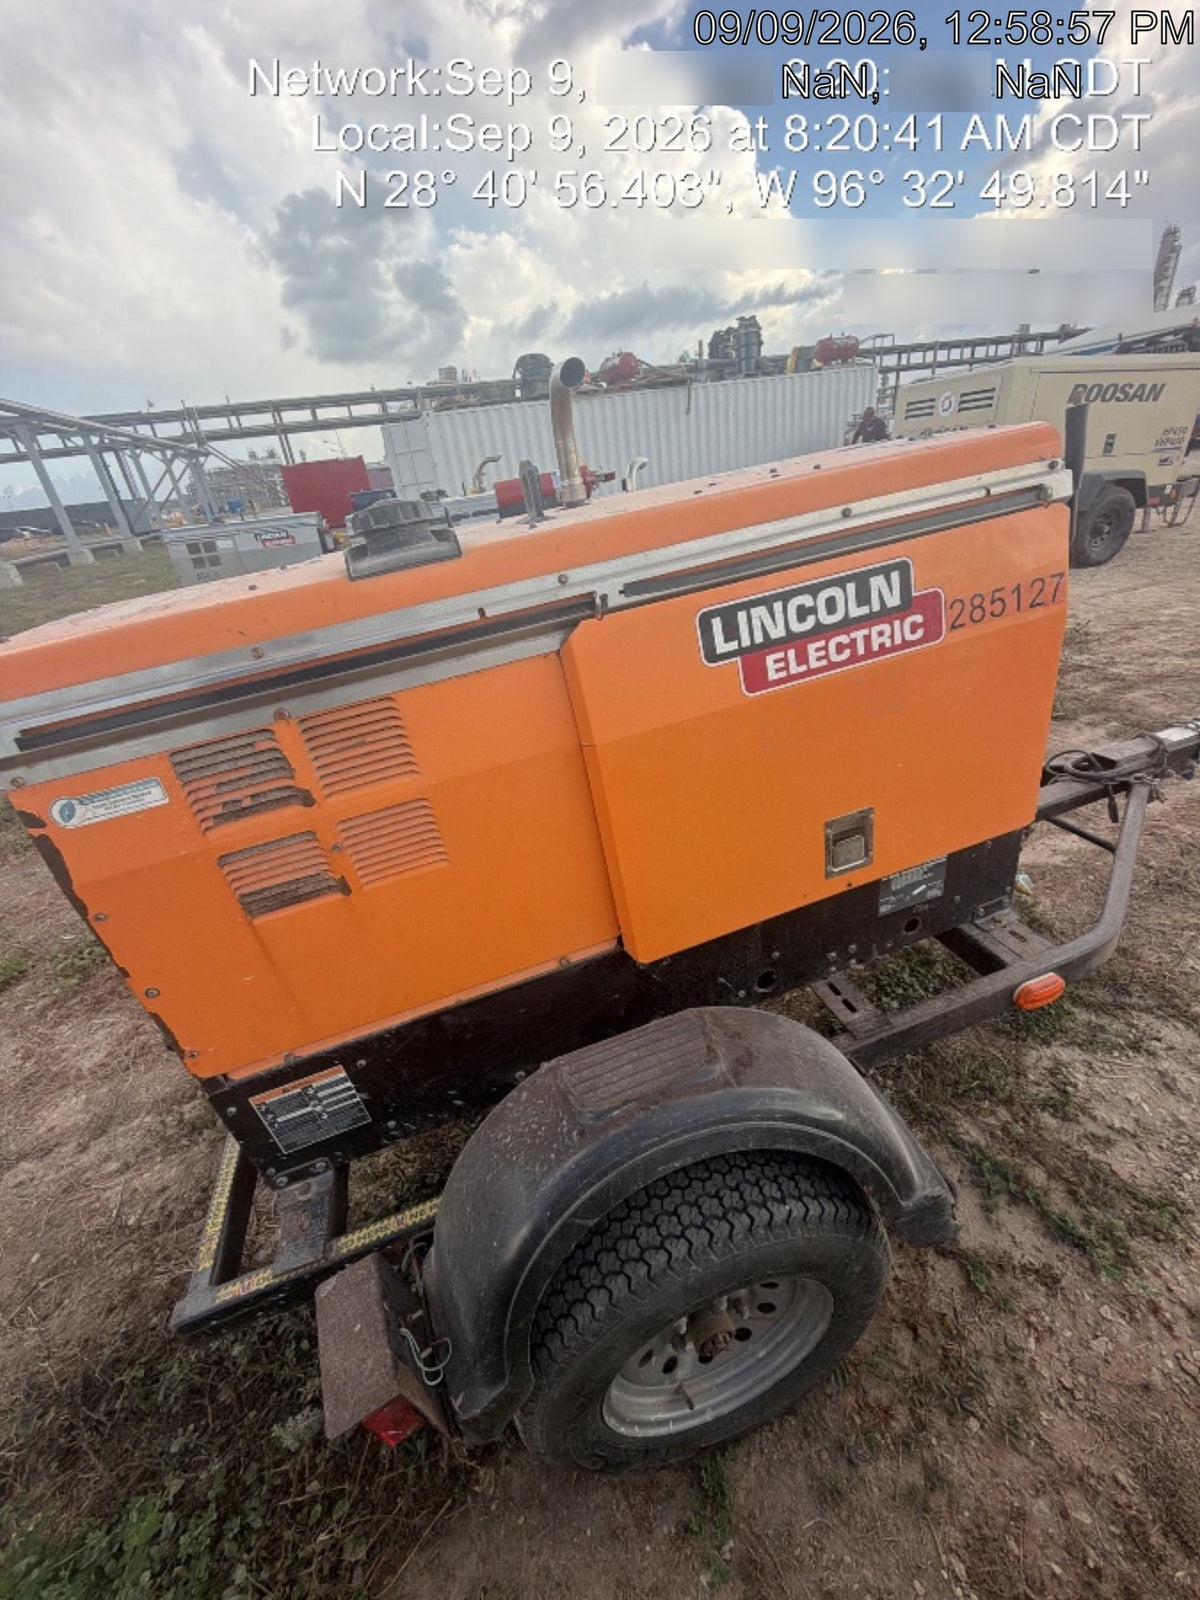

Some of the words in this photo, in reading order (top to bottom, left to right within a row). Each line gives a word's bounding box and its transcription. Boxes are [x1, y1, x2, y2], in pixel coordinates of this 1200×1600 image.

[711, 570, 903, 655] LINCOLN
[949, 572, 1065, 631] 285127
[766, 614, 924, 682] ELECTRIC
